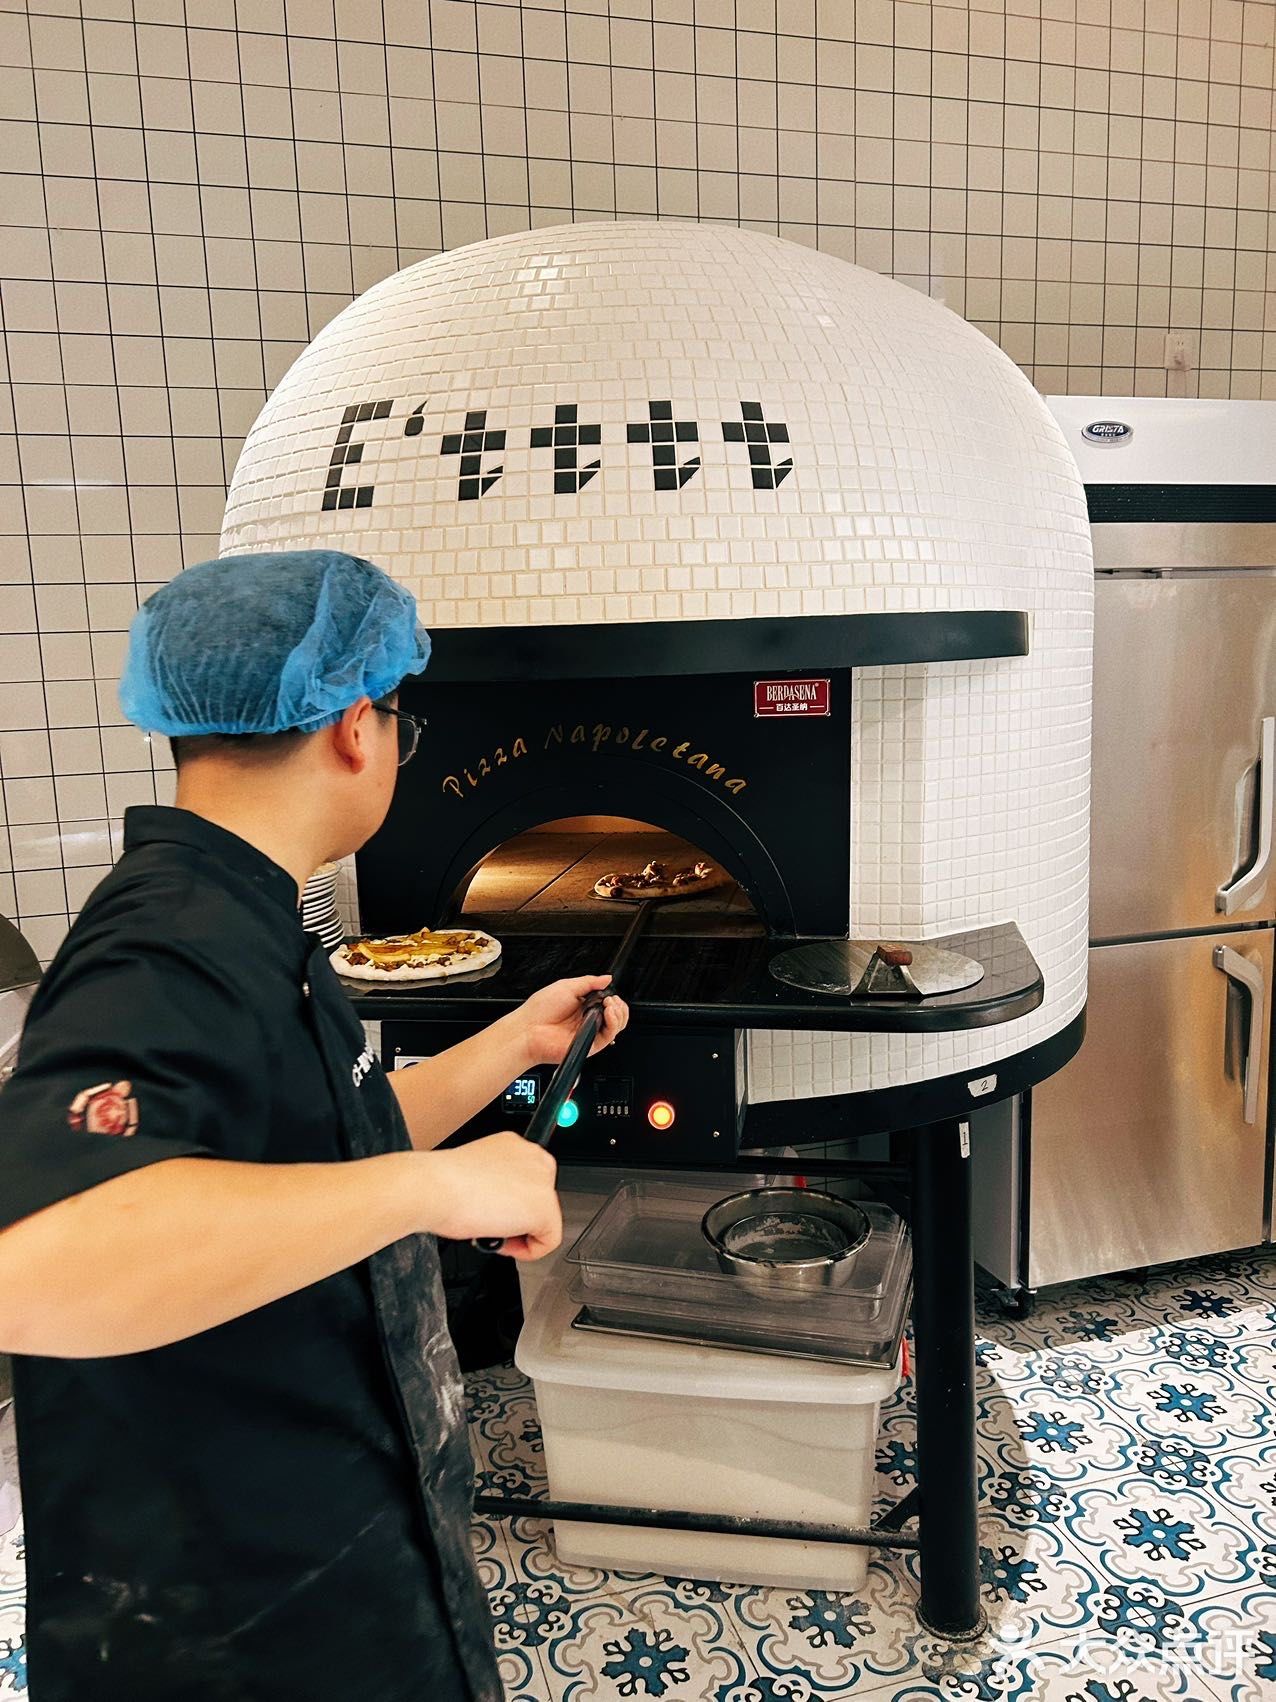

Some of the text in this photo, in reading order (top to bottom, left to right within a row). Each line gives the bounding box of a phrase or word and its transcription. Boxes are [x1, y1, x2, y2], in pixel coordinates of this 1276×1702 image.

[766, 685, 817, 701] BERDASENA
[776, 703, 808, 711] 百达圣纳
[442, 723, 747, 798] Pizza Napoletana
[514, 1079, 536, 1096] 350
[980, 1079, 989, 1092] 2
